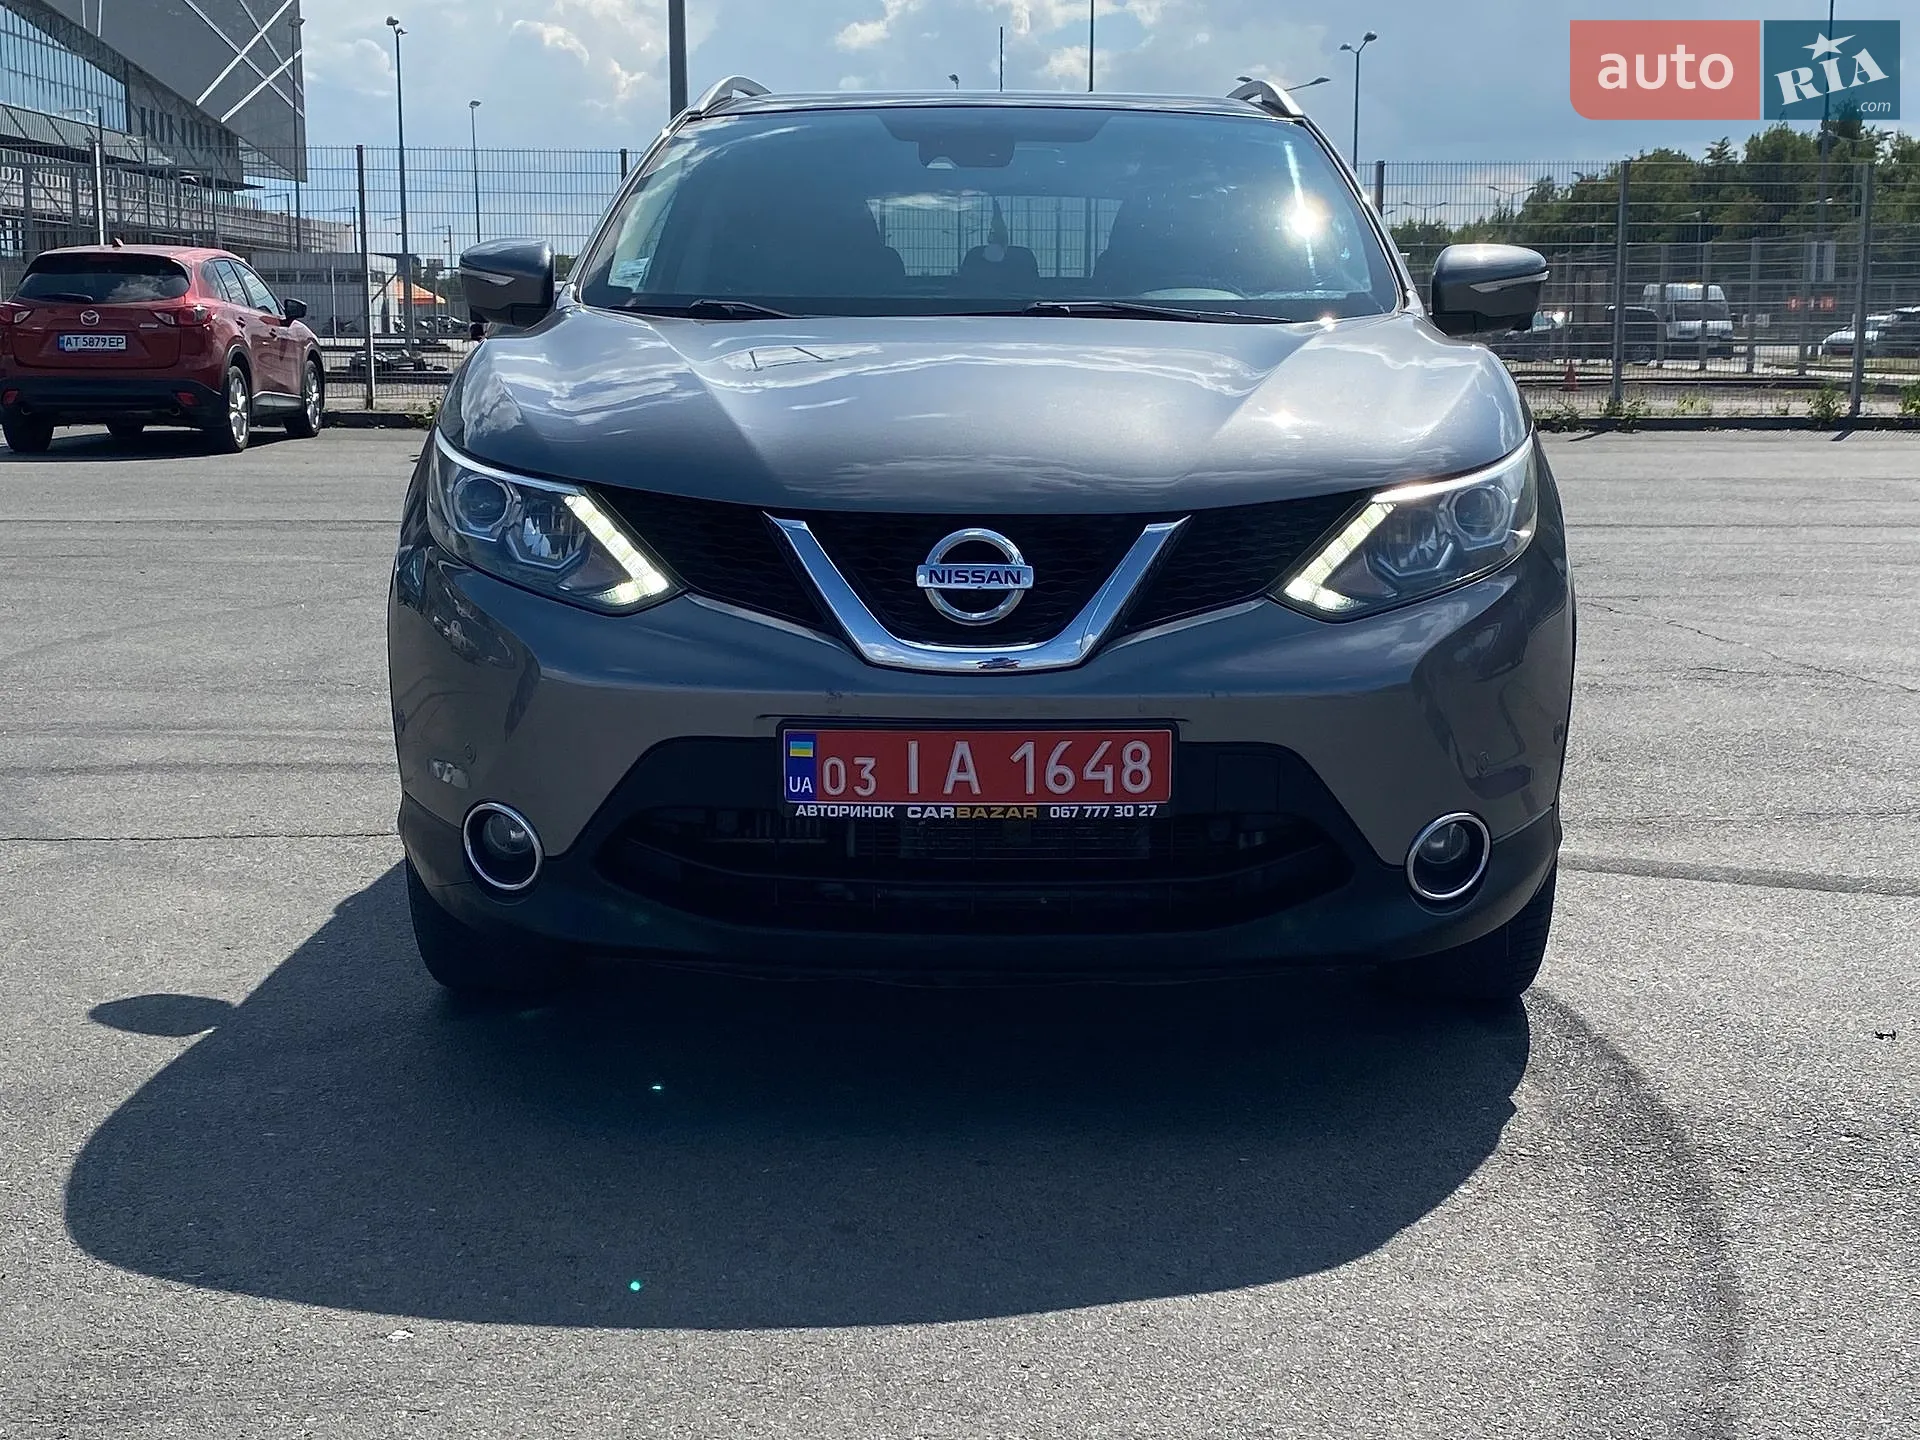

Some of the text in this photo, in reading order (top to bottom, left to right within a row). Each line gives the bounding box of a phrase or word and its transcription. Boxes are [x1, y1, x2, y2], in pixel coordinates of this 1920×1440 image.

[65, 336, 124, 347] AT 5879 EP
[928, 569, 1021, 585] NISSAN
[822, 756, 877, 796] 03
[1009, 740, 1152, 795] 1648
[789, 776, 813, 794] UA
[795, 805, 1158, 819] АВТОРИНОК CARBAZAR 067 777 30 27
